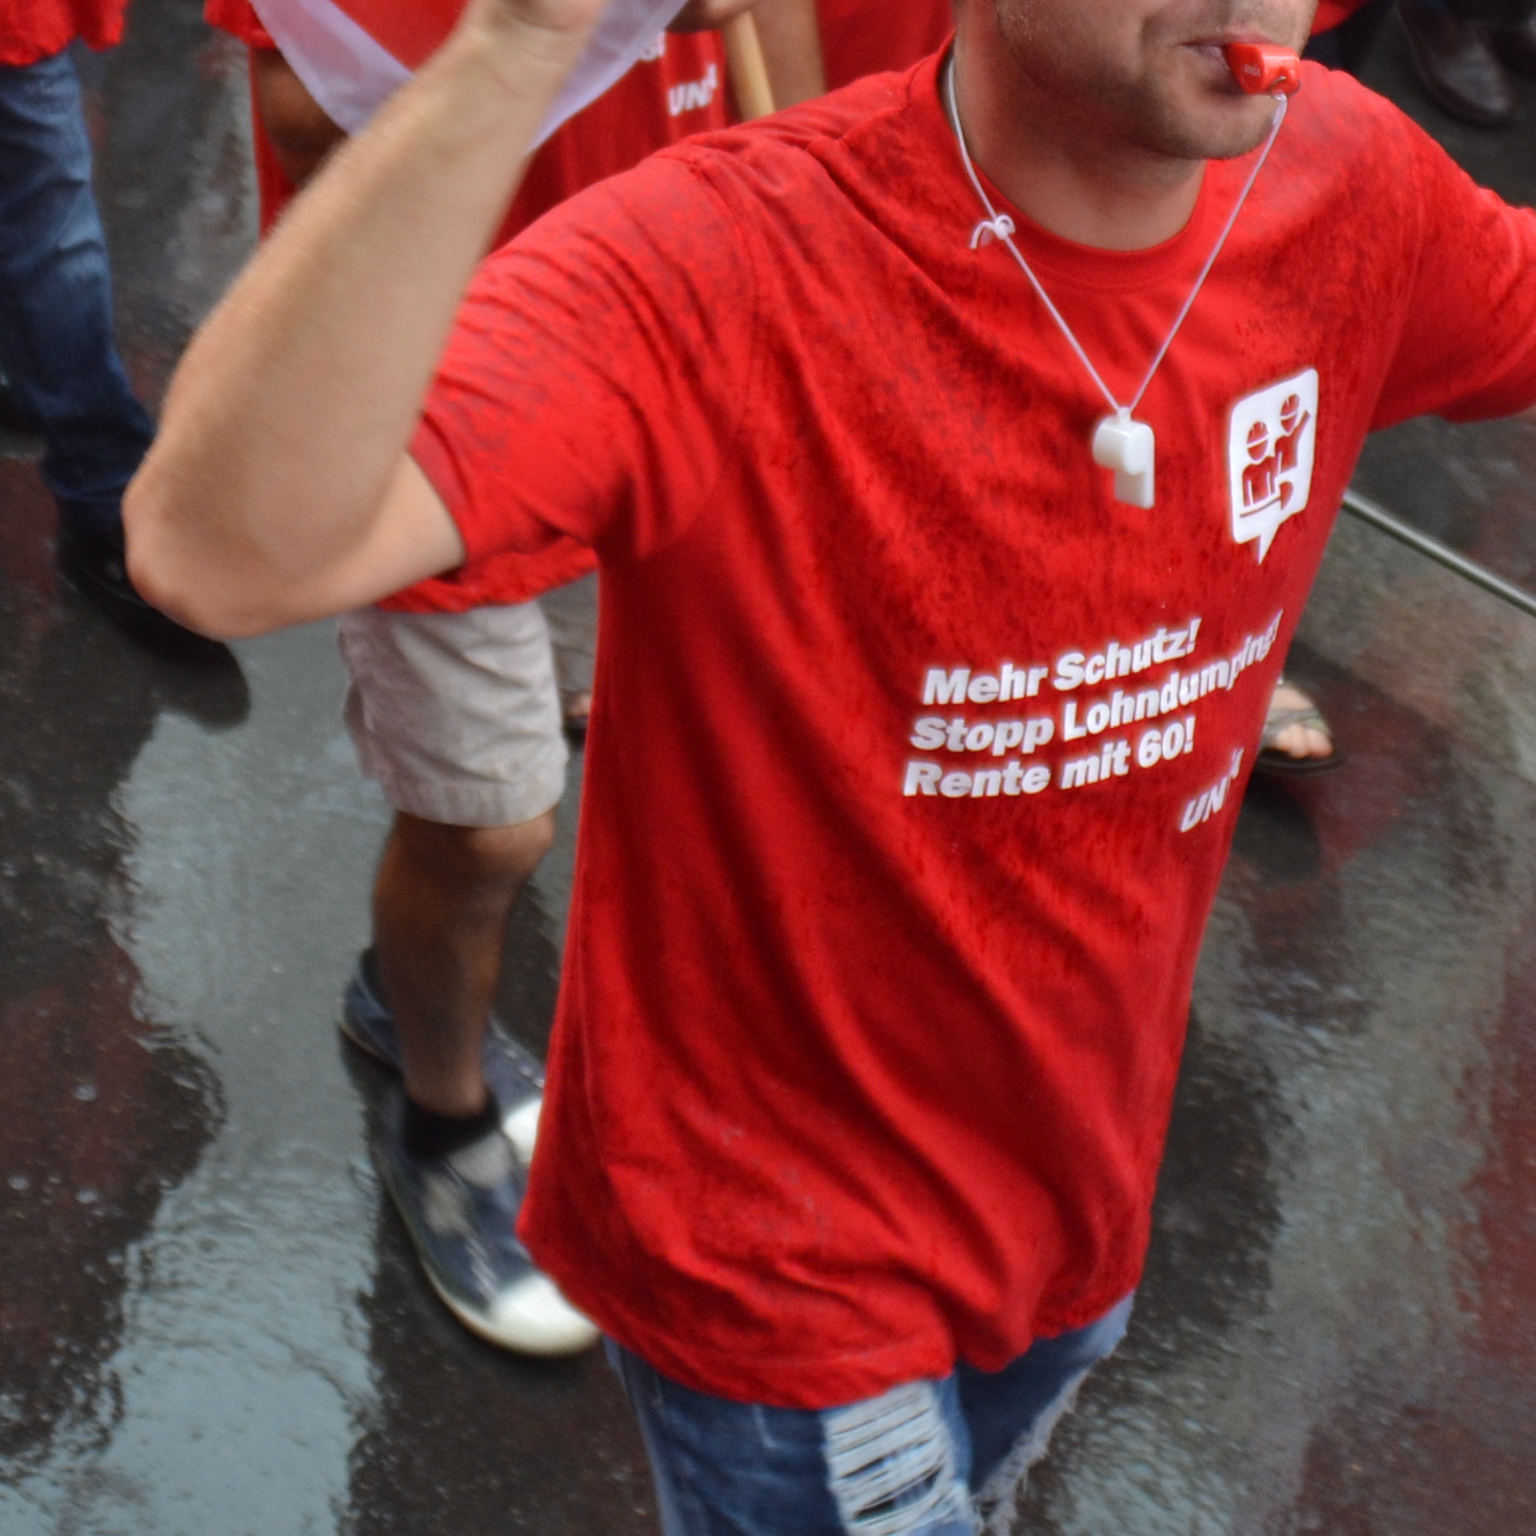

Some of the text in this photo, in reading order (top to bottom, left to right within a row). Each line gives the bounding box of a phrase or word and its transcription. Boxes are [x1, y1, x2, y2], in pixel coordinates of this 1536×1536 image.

[923, 617, 1202, 705] Mehr Schutz!
[903, 716, 1196, 798] Rente mit 60!
[911, 714, 1055, 756] Stopp
